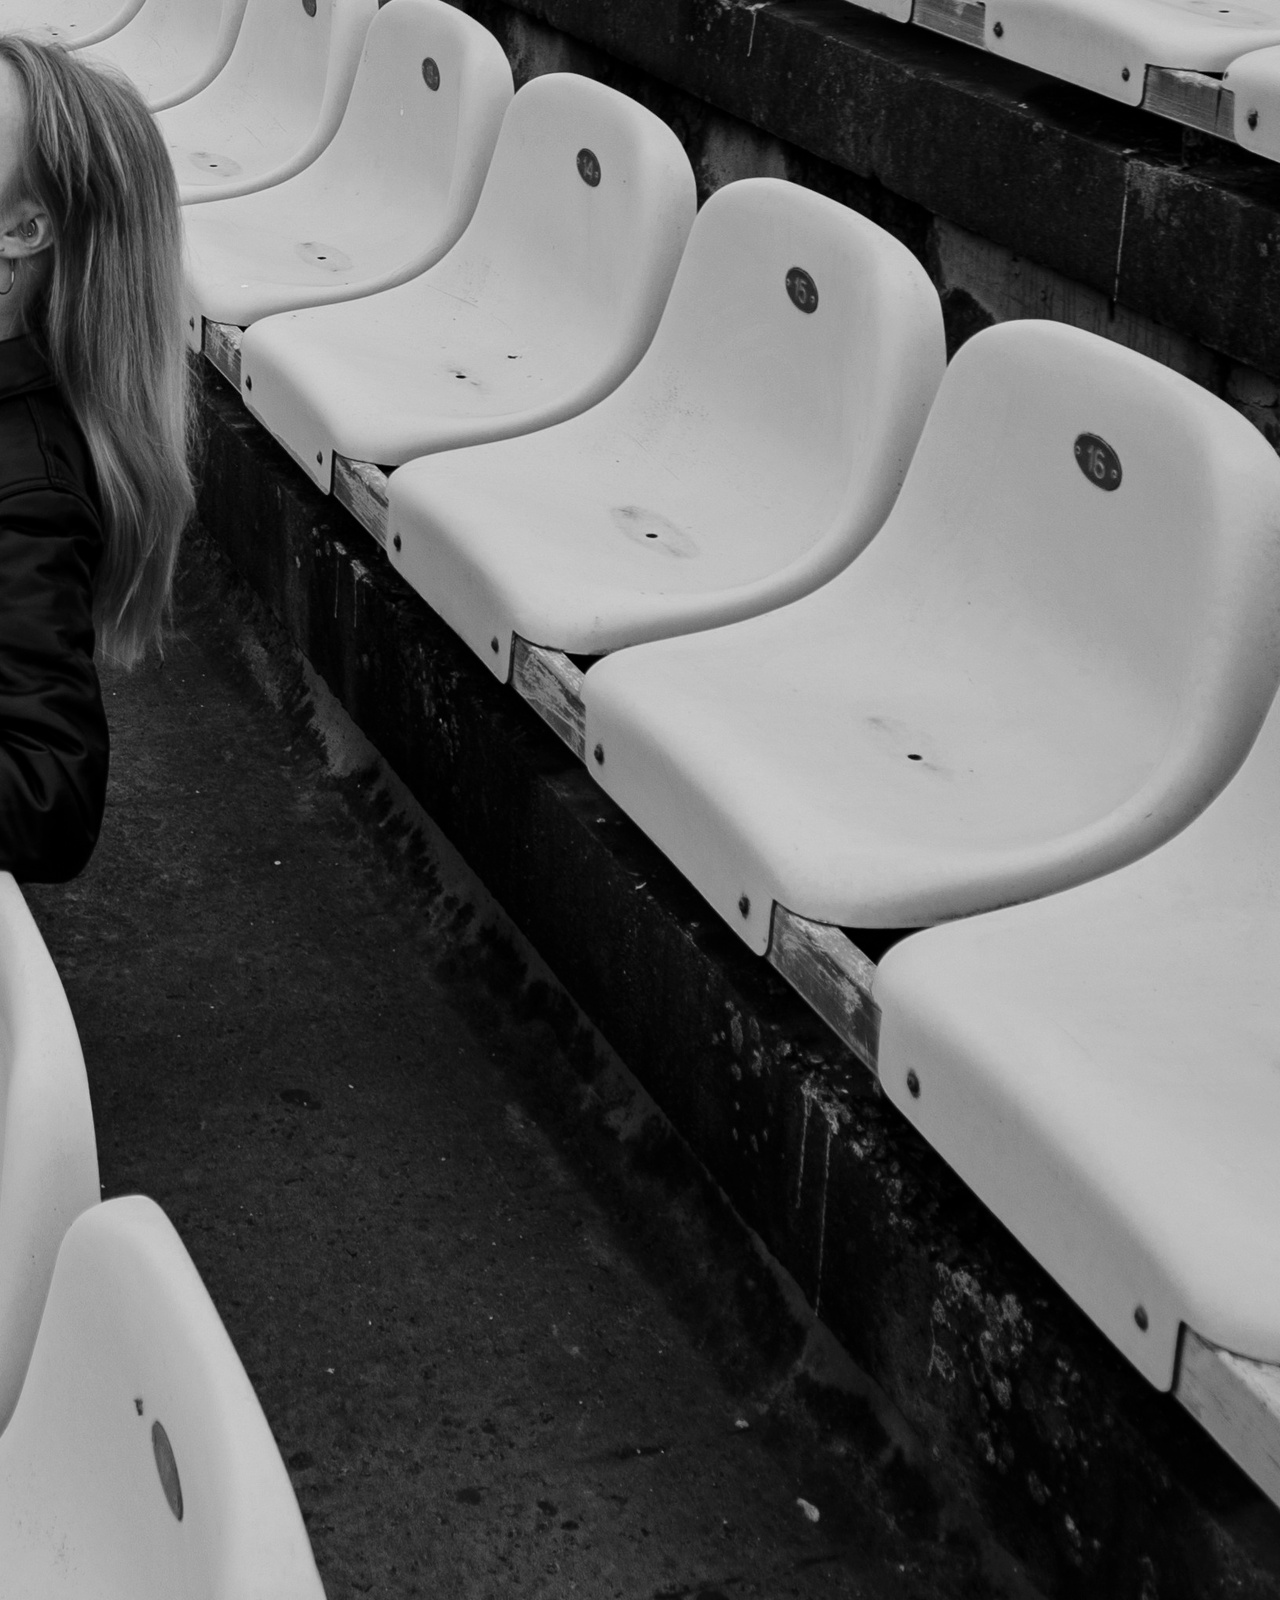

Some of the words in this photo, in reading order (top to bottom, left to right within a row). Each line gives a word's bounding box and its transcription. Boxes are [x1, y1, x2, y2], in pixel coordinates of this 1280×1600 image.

[582, 156, 594, 180] 14
[794, 276, 807, 304] 15
[1087, 444, 1106, 480] 16
